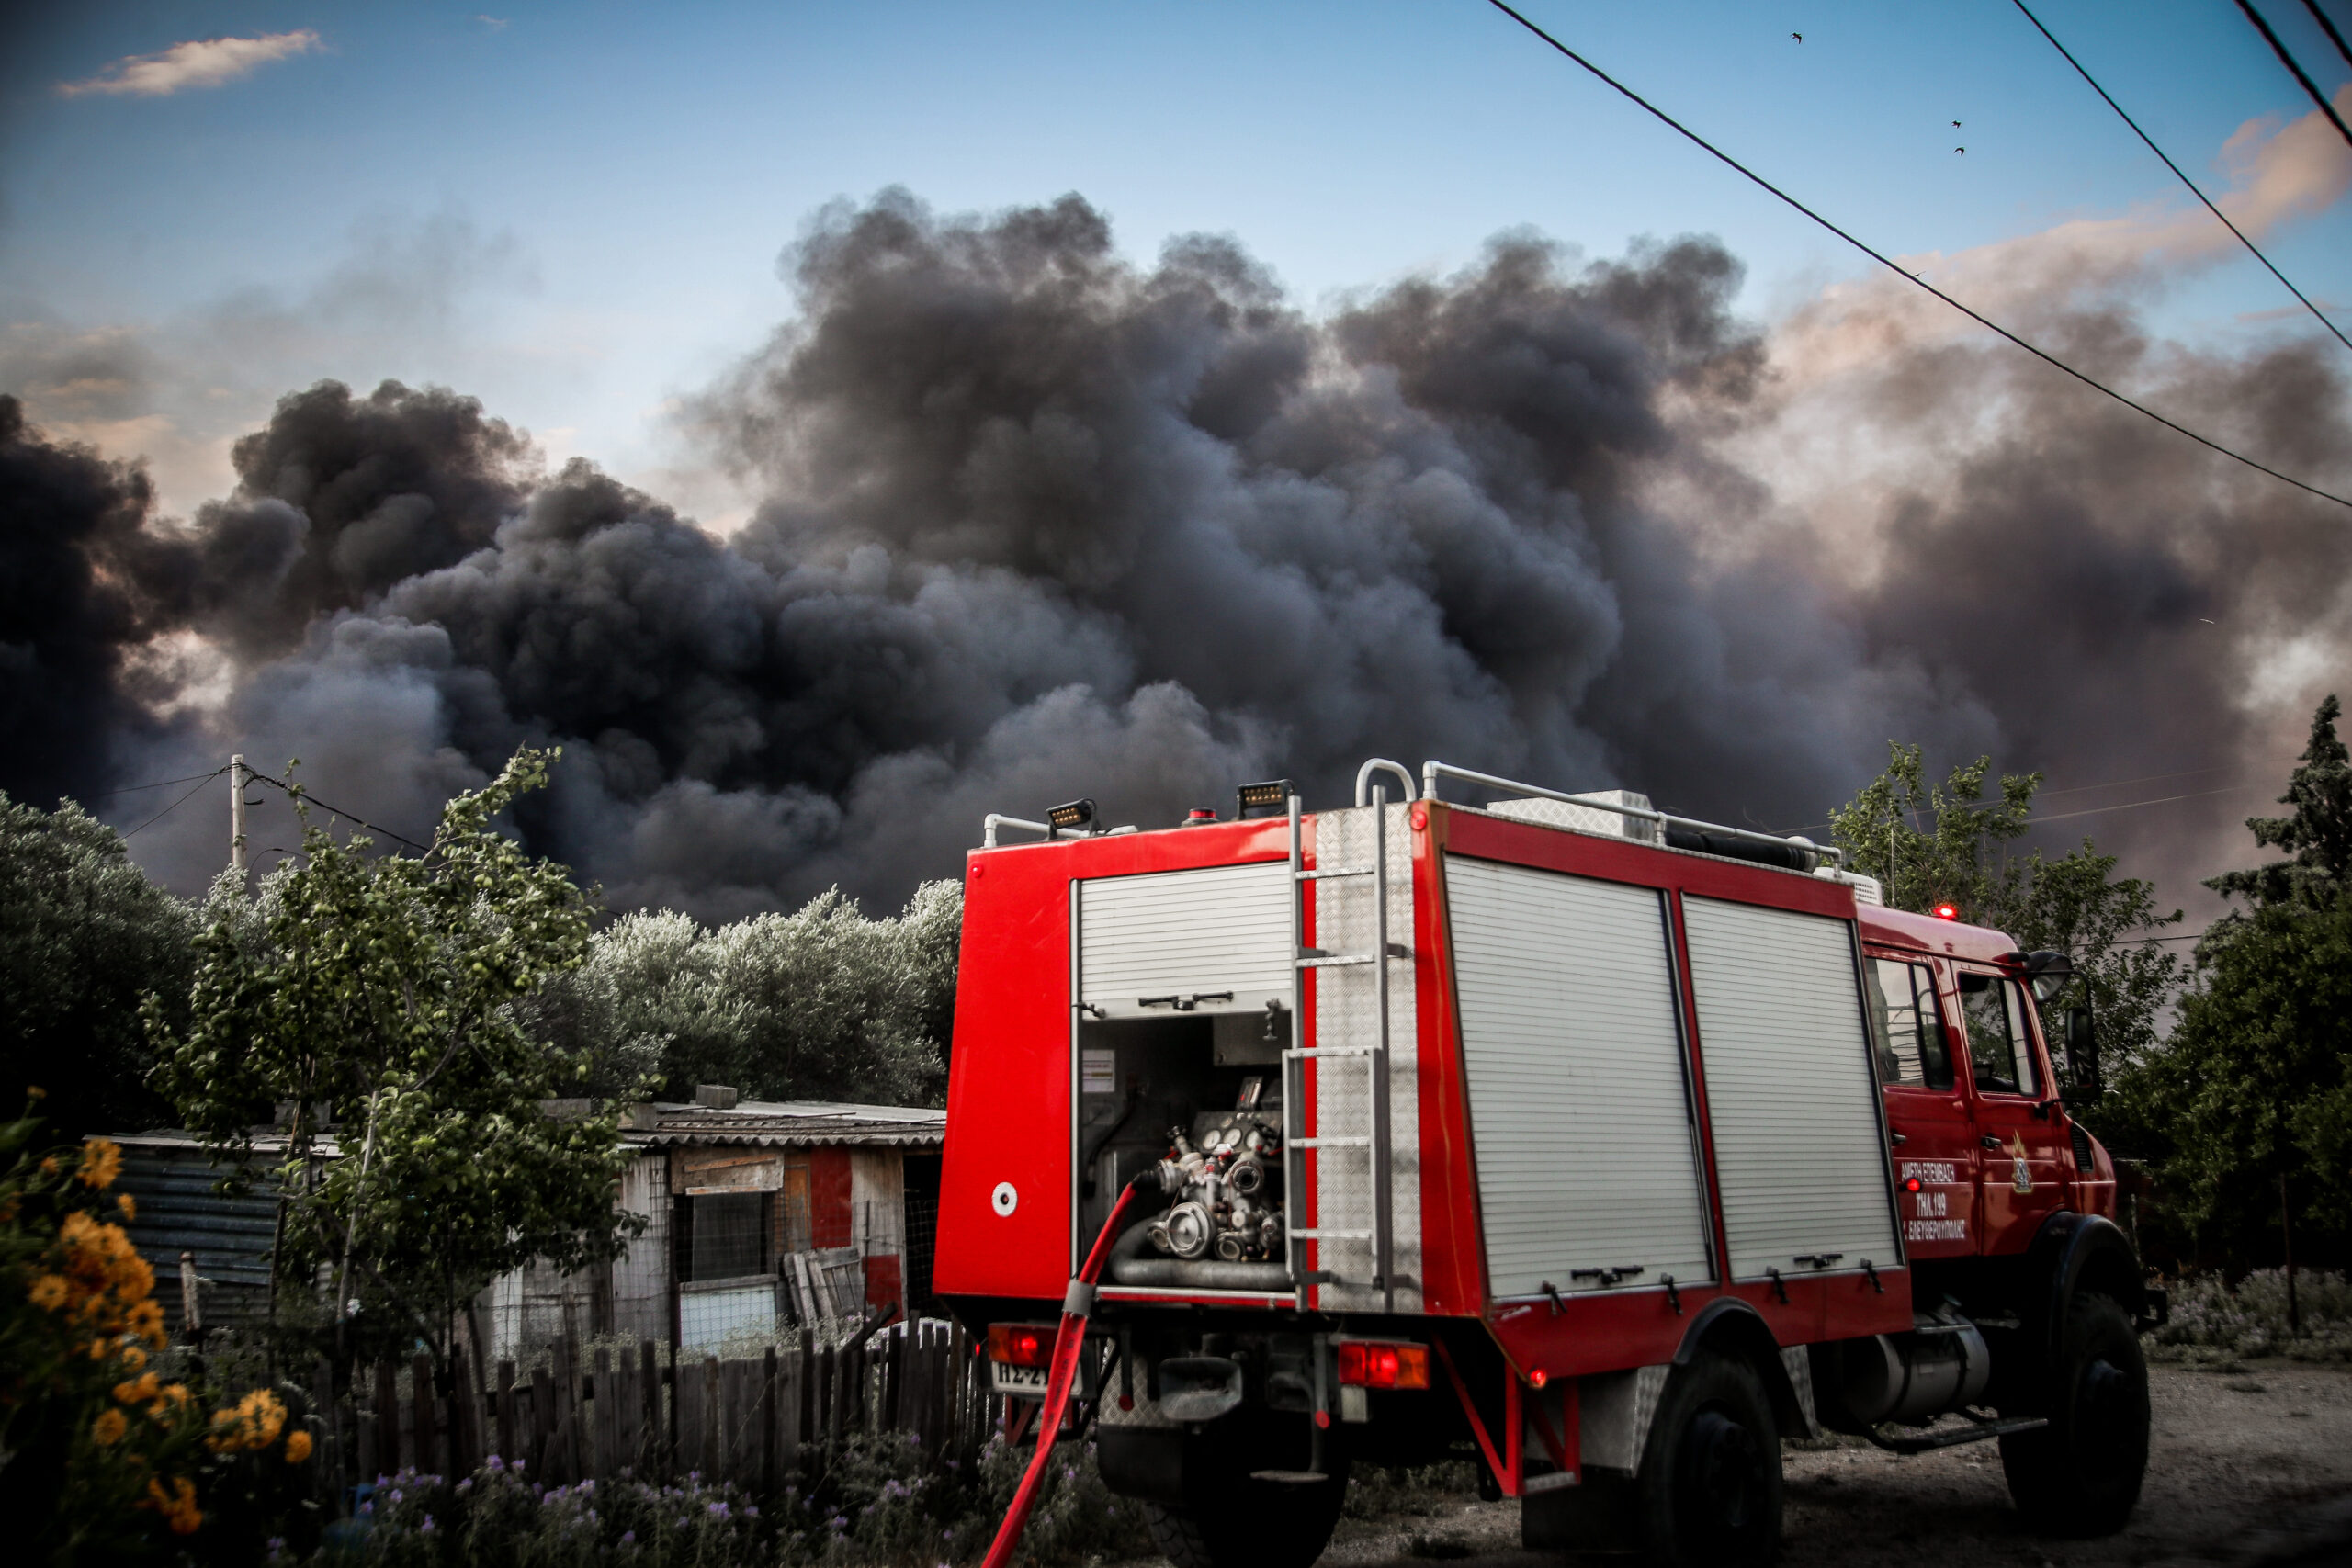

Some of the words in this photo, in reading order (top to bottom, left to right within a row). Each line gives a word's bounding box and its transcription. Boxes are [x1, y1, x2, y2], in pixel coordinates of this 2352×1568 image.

[1901, 1162, 1923, 1182] ΑΜΕΣΗ
[1922, 1162, 1955, 1183] ΕΠΕΜΒΑΣΗ
[1908, 1219, 1965, 1240] ΕΛΕΥΘΕΡΟΥΠΟΛΗΣ
